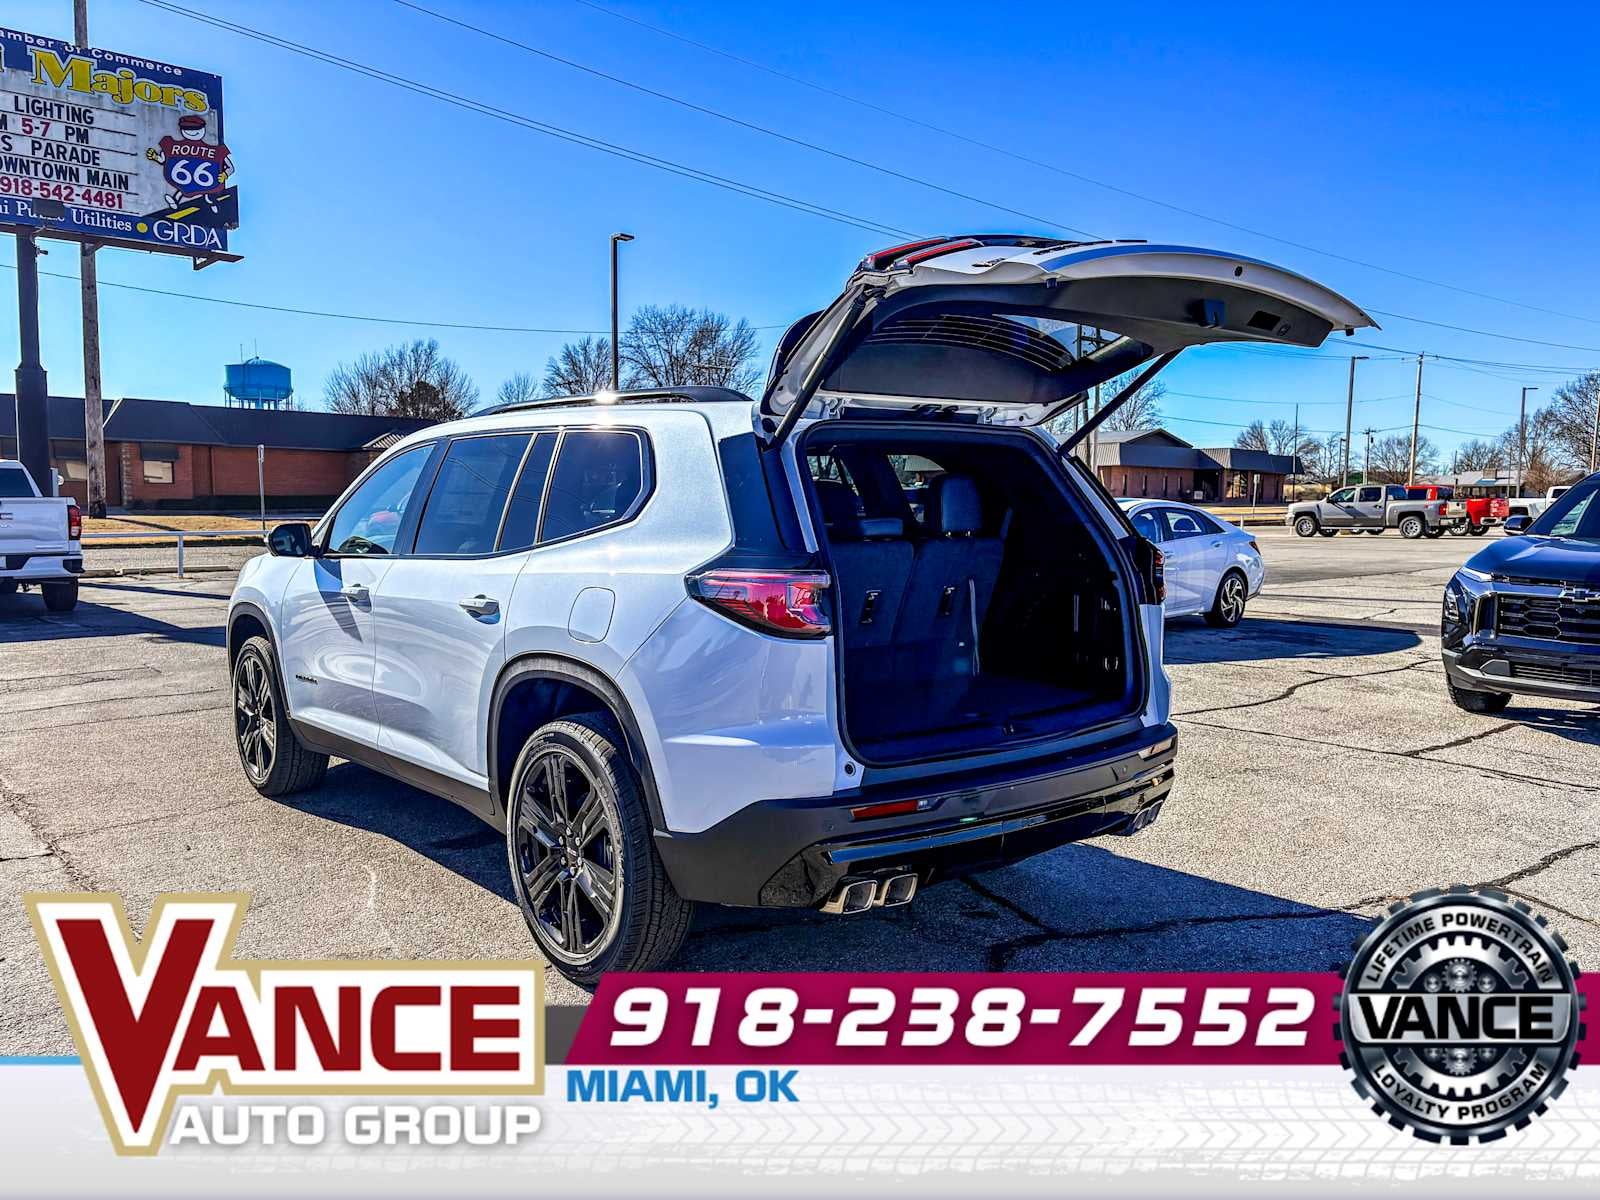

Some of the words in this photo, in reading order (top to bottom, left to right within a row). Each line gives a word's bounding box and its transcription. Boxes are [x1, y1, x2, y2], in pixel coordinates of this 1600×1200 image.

[91, 48, 183, 77] Commerce
[30, 47, 209, 113] Majors
[14, 95, 95, 125] LIGHTING
[21, 117, 51, 137] 5-7
[64, 125, 90, 145] PM
[0, 135, 13, 152] S
[31, 139, 101, 167] PARADE
[171, 144, 216, 159] ROUTE
[0, 155, 80, 184] WNTOWN
[86, 168, 129, 191] MAIN
[171, 159, 214, 187] 66
[0, 175, 123, 209] 918-542-4481
[71, 208, 133, 232] Utilities
[152, 219, 223, 249] GRDA
